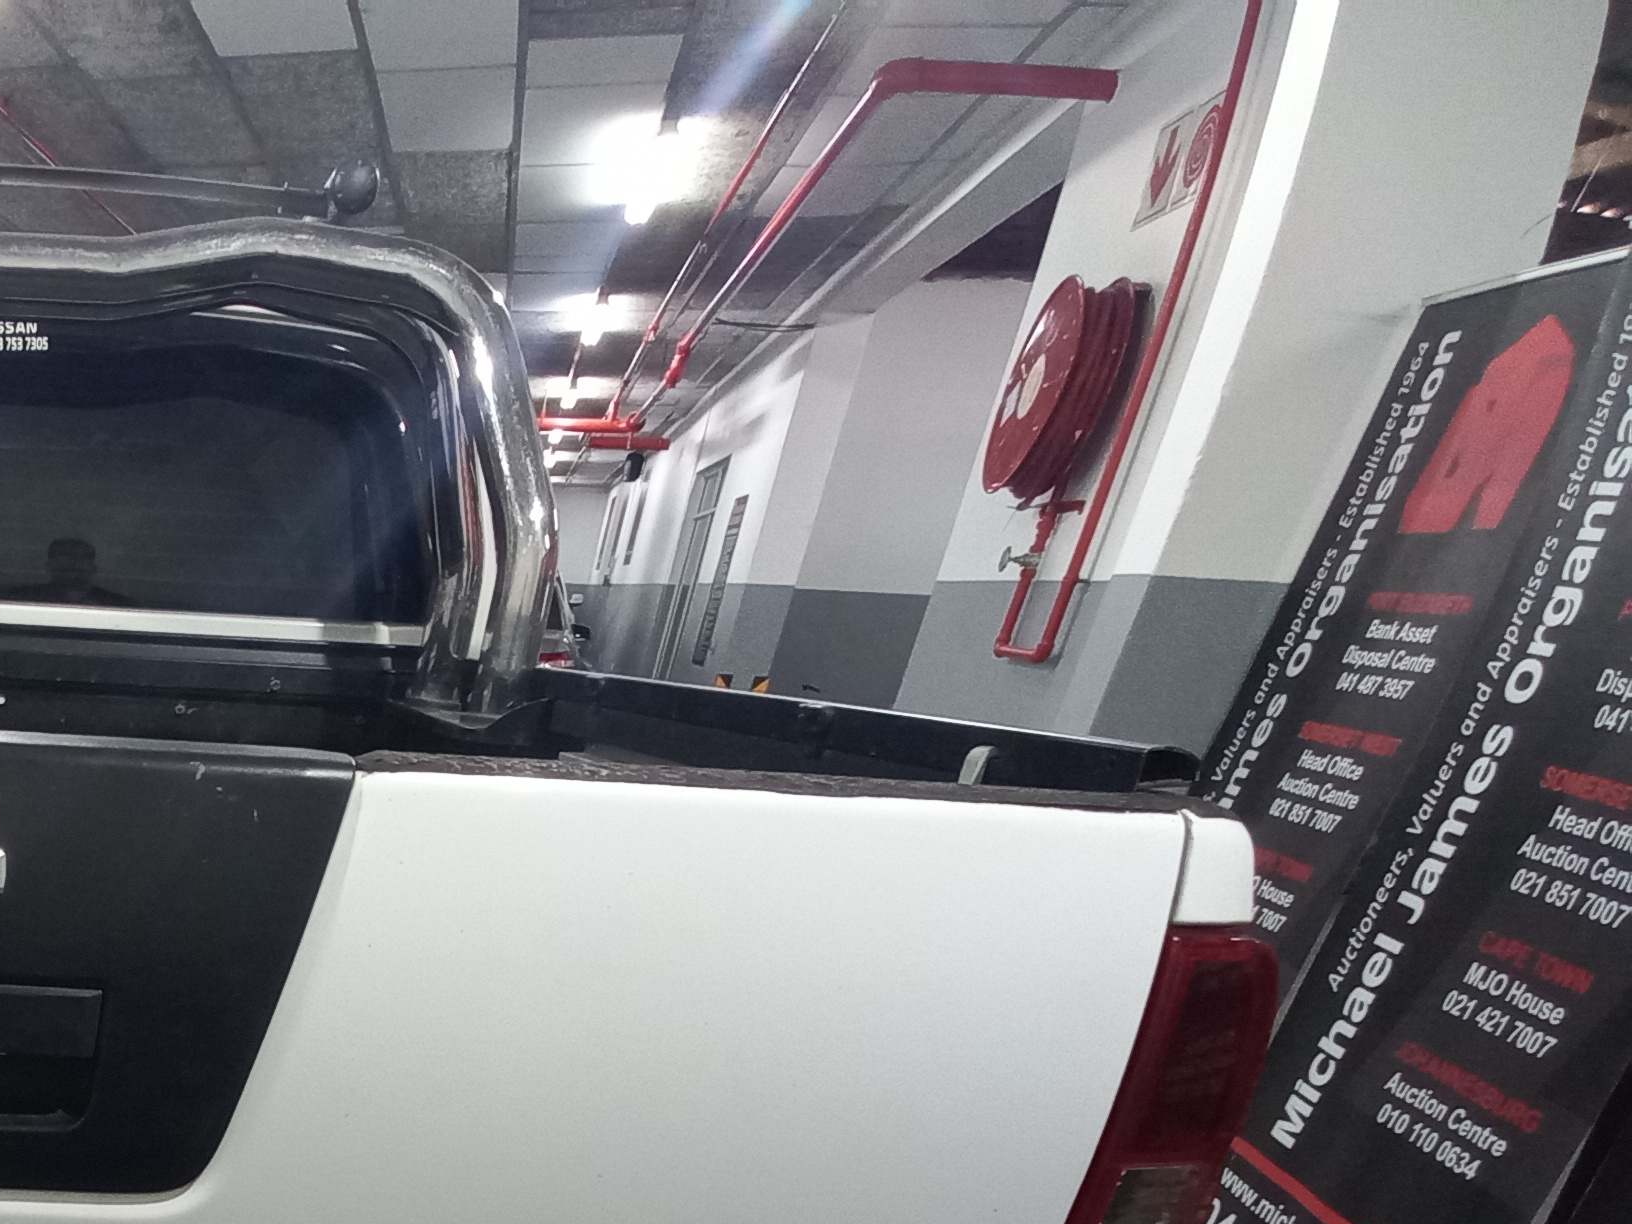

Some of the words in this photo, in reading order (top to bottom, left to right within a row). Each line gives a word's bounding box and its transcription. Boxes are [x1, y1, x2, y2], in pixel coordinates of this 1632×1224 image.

[5, 337, 23, 351] 753
[25, 337, 49, 351] 7305
[1285, 330, 1463, 678] Organisation
[1211, 709, 1256, 781] Valuers
[1254, 662, 1280, 705] and
[1276, 549, 1338, 660] Appraisers
[1339, 403, 1403, 528] Established
[1398, 342, 1430, 396] 1964
[1365, 619, 1402, 641] Bank
[1397, 621, 1439, 644] Asset
[1328, 847, 1415, 992] Auctioneers,
[1405, 741, 1465, 836] Valuers
[1460, 682, 1494, 736] and
[1487, 533, 1560, 679] Appraisers
[1558, 352, 1628, 512] Established
[1342, 645, 1392, 669] Disposal
[1391, 650, 1436, 674] Centre
[1335, 672, 1358, 692] 041
[1270, 932, 1406, 1149] Michael
[1396, 724, 1514, 926] James
[1504, 385, 1632, 704] Organisa
[1297, 749, 1333, 773] Head
[1327, 754, 1365, 781] Office
[1277, 772, 1320, 800] Auction
[1319, 783, 1360, 810] Centre
[1287, 802, 1312, 826] 851
[1313, 810, 1343, 834] 7007
[1548, 804, 1603, 839] Head
[1517, 834, 1590, 876] Auction
[1256, 879, 1295, 908] House
[1510, 868, 1548, 898] 021
[1544, 880, 1582, 911] 851
[1578, 893, 1632, 929] 7007
[1255, 908, 1287, 933] 7007
[1462, 962, 1509, 996] MJO
[1505, 980, 1566, 1025] House
[1441, 990, 1478, 1021] 021
[1474, 1006, 1511, 1037] 421
[1506, 1020, 1559, 1058] 7007
[1383, 1071, 1449, 1122] Auction
[1447, 1108, 1508, 1157] Centre
[1376, 1103, 1411, 1134] 010
[1408, 1122, 1439, 1153] 110
[1435, 1141, 1483, 1180] 0634
